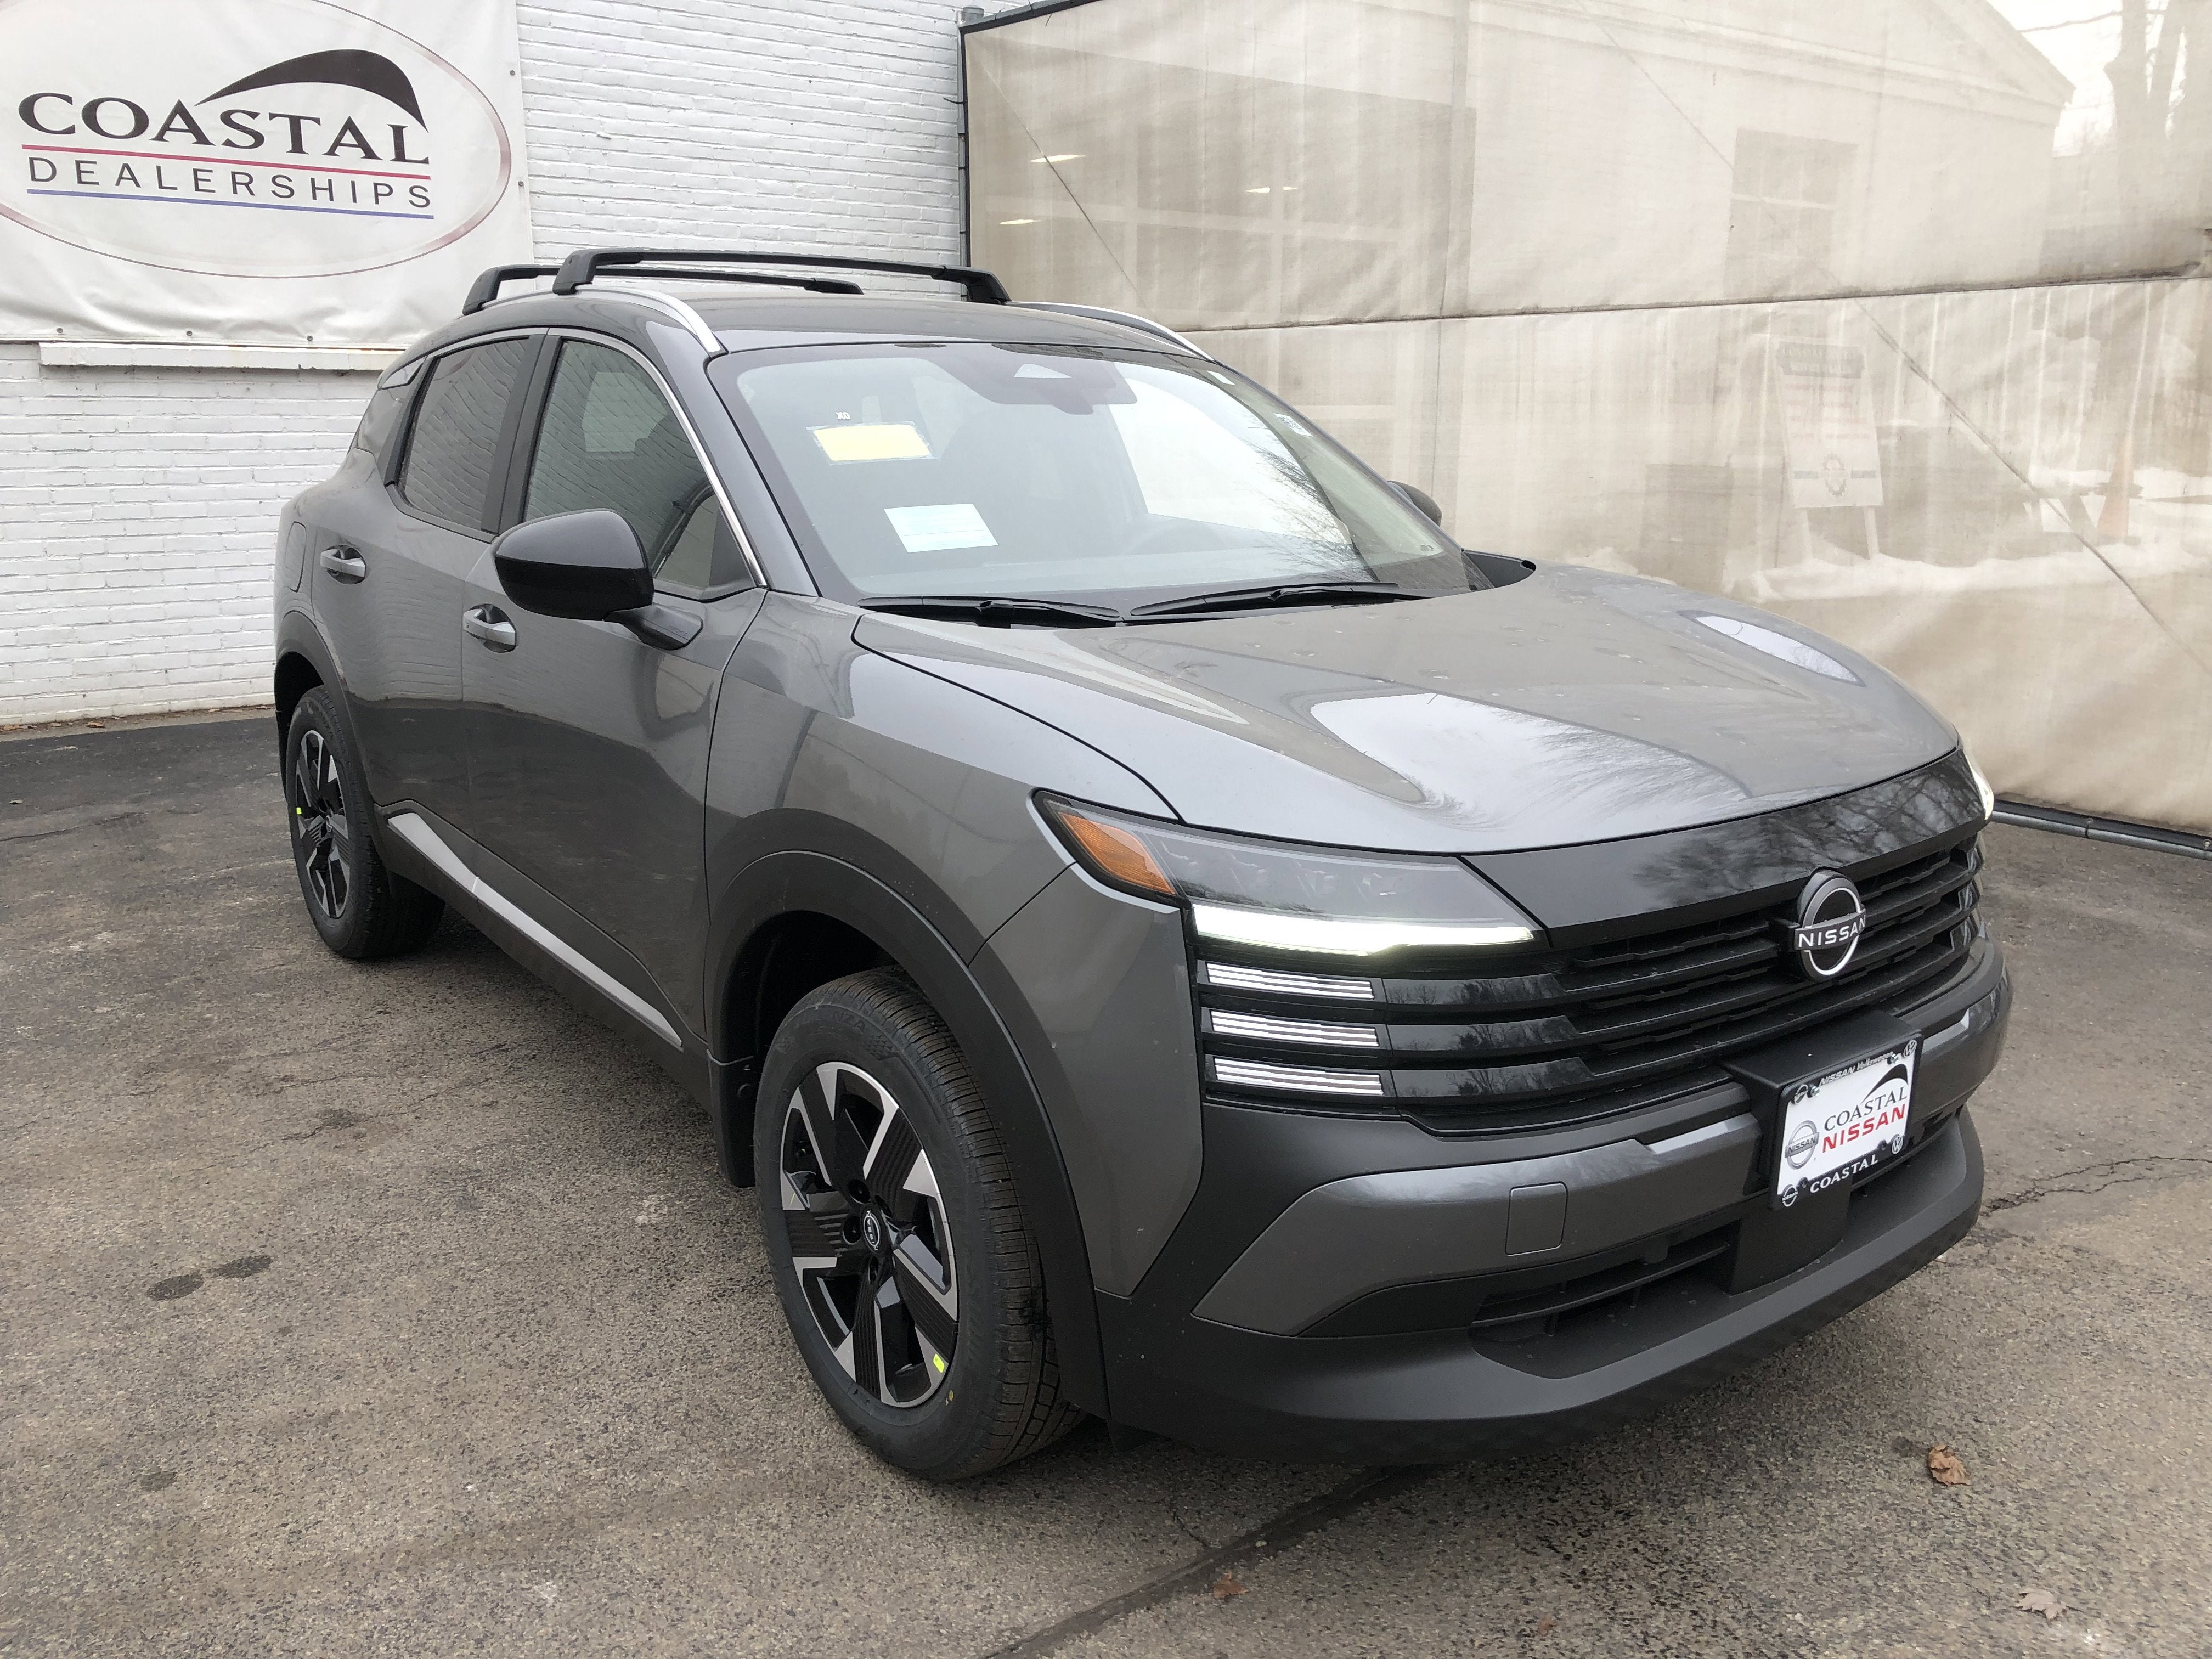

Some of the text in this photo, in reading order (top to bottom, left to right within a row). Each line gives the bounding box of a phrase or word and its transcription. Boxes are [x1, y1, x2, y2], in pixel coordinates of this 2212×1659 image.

[18, 92, 430, 165] COASTAL
[29, 157, 431, 208] DEALERSHIPS
[1798, 915, 1866, 947] NISSAN
[1819, 1065, 1856, 1086] NISSAN
[1822, 1103, 1906, 1153] NISSAN
[1824, 1086, 1908, 1131] COASTAL
[1787, 1136, 1816, 1153] NISSAN
[1810, 1154, 1878, 1193] COASTAL
